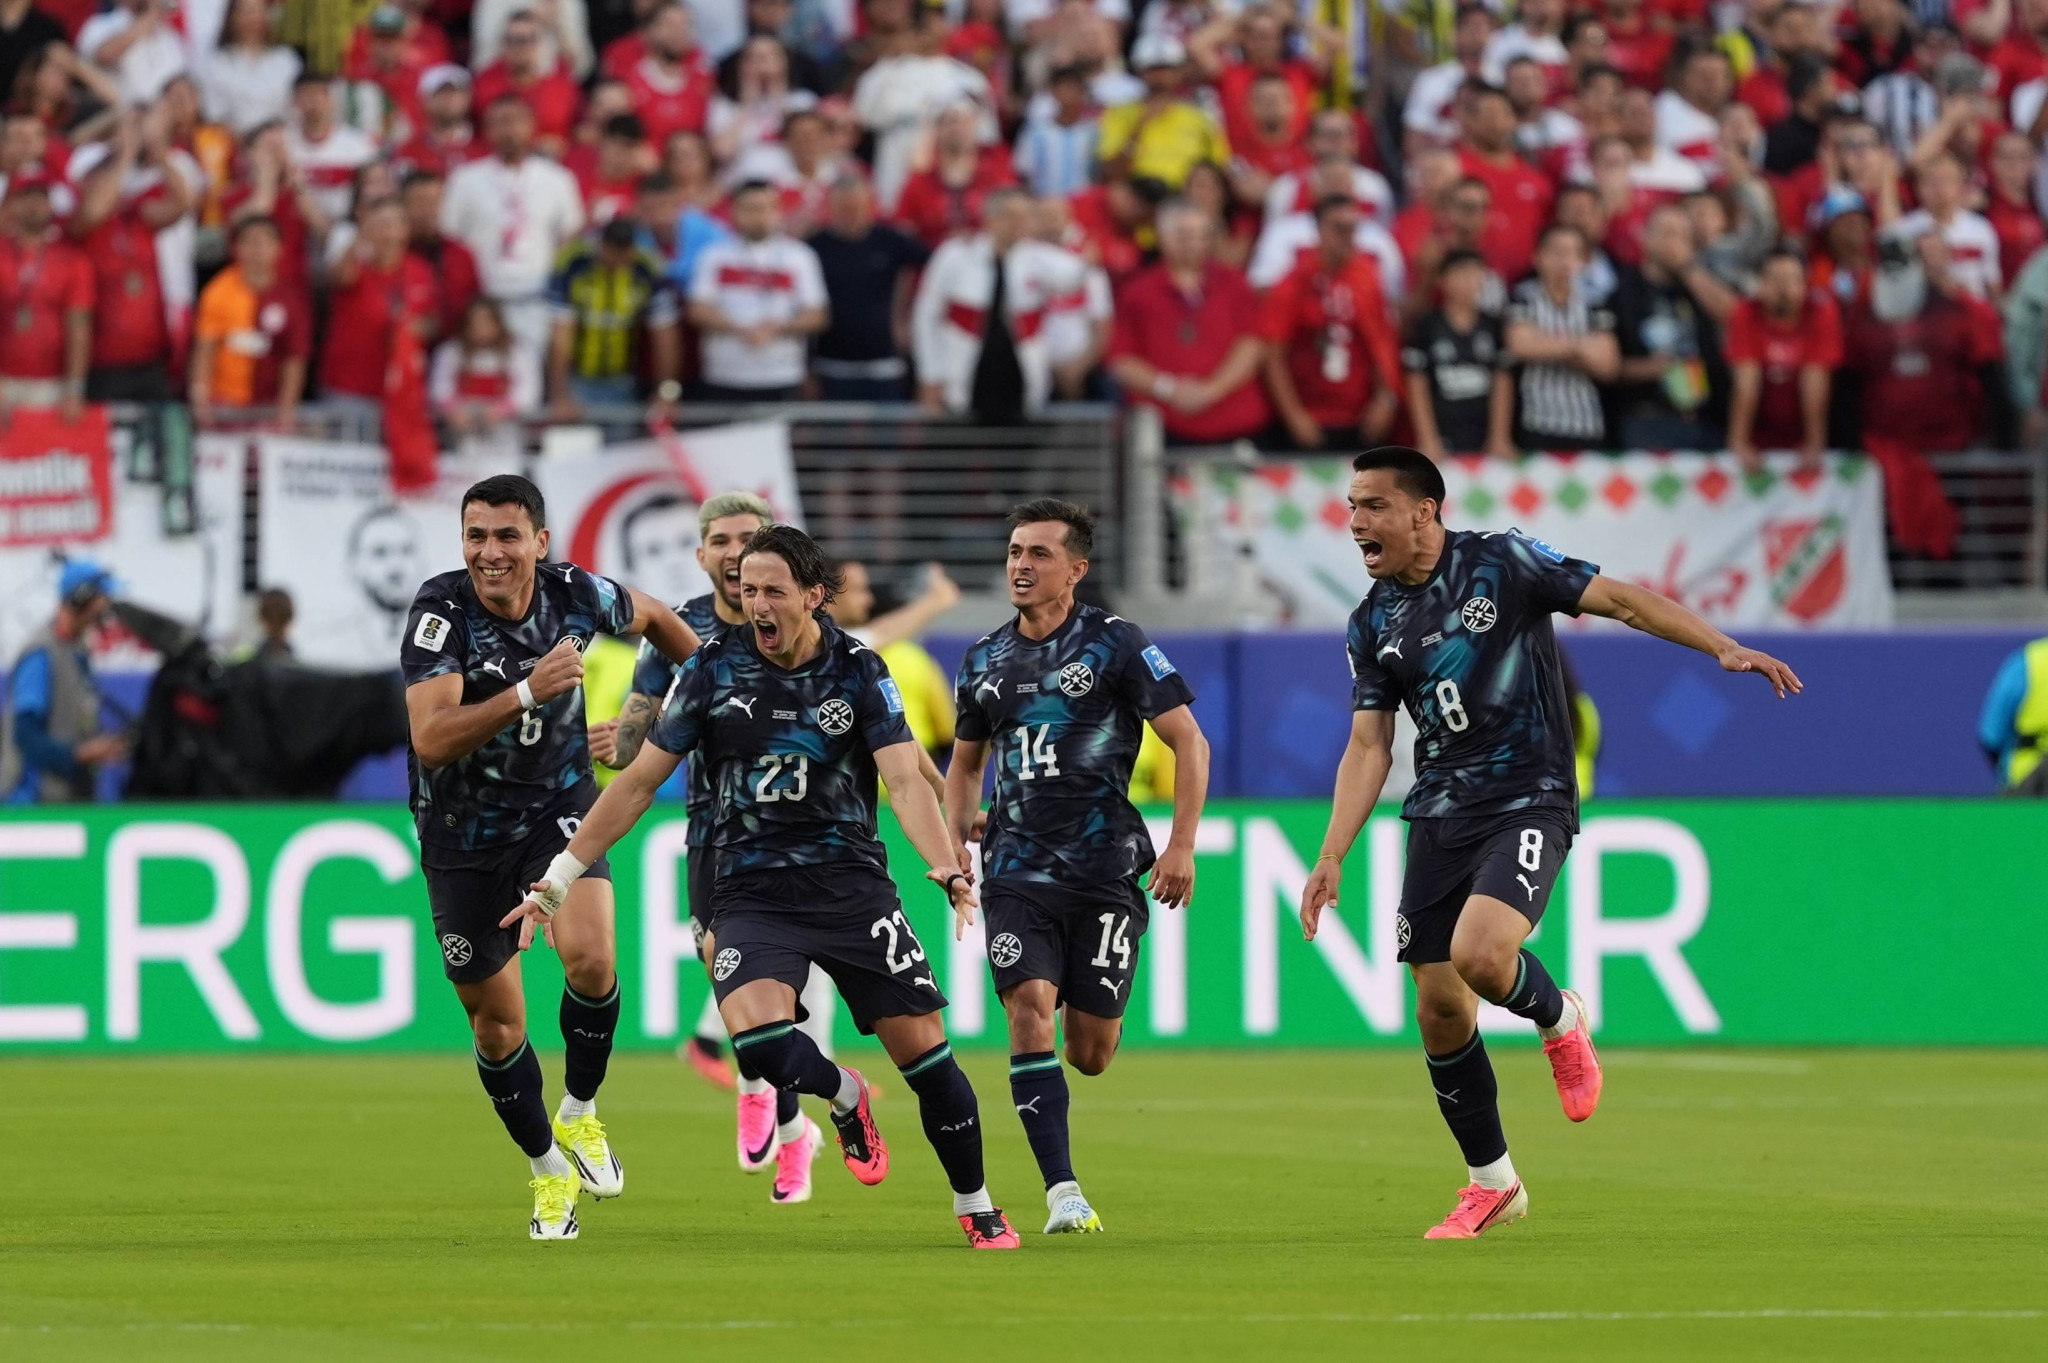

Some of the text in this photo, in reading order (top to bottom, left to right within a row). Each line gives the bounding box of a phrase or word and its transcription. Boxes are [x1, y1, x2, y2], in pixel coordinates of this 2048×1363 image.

[519, 706, 544, 746] 6
[1436, 678, 1469, 733] 8
[1014, 723, 1060, 781] 14
[755, 754, 808, 802] 23
[1518, 828, 1545, 872] 8
[870, 909, 926, 975] 23
[1091, 912, 1131, 970] 14
[573, 1028, 609, 1040] APF
[940, 1116, 974, 1131] APF
